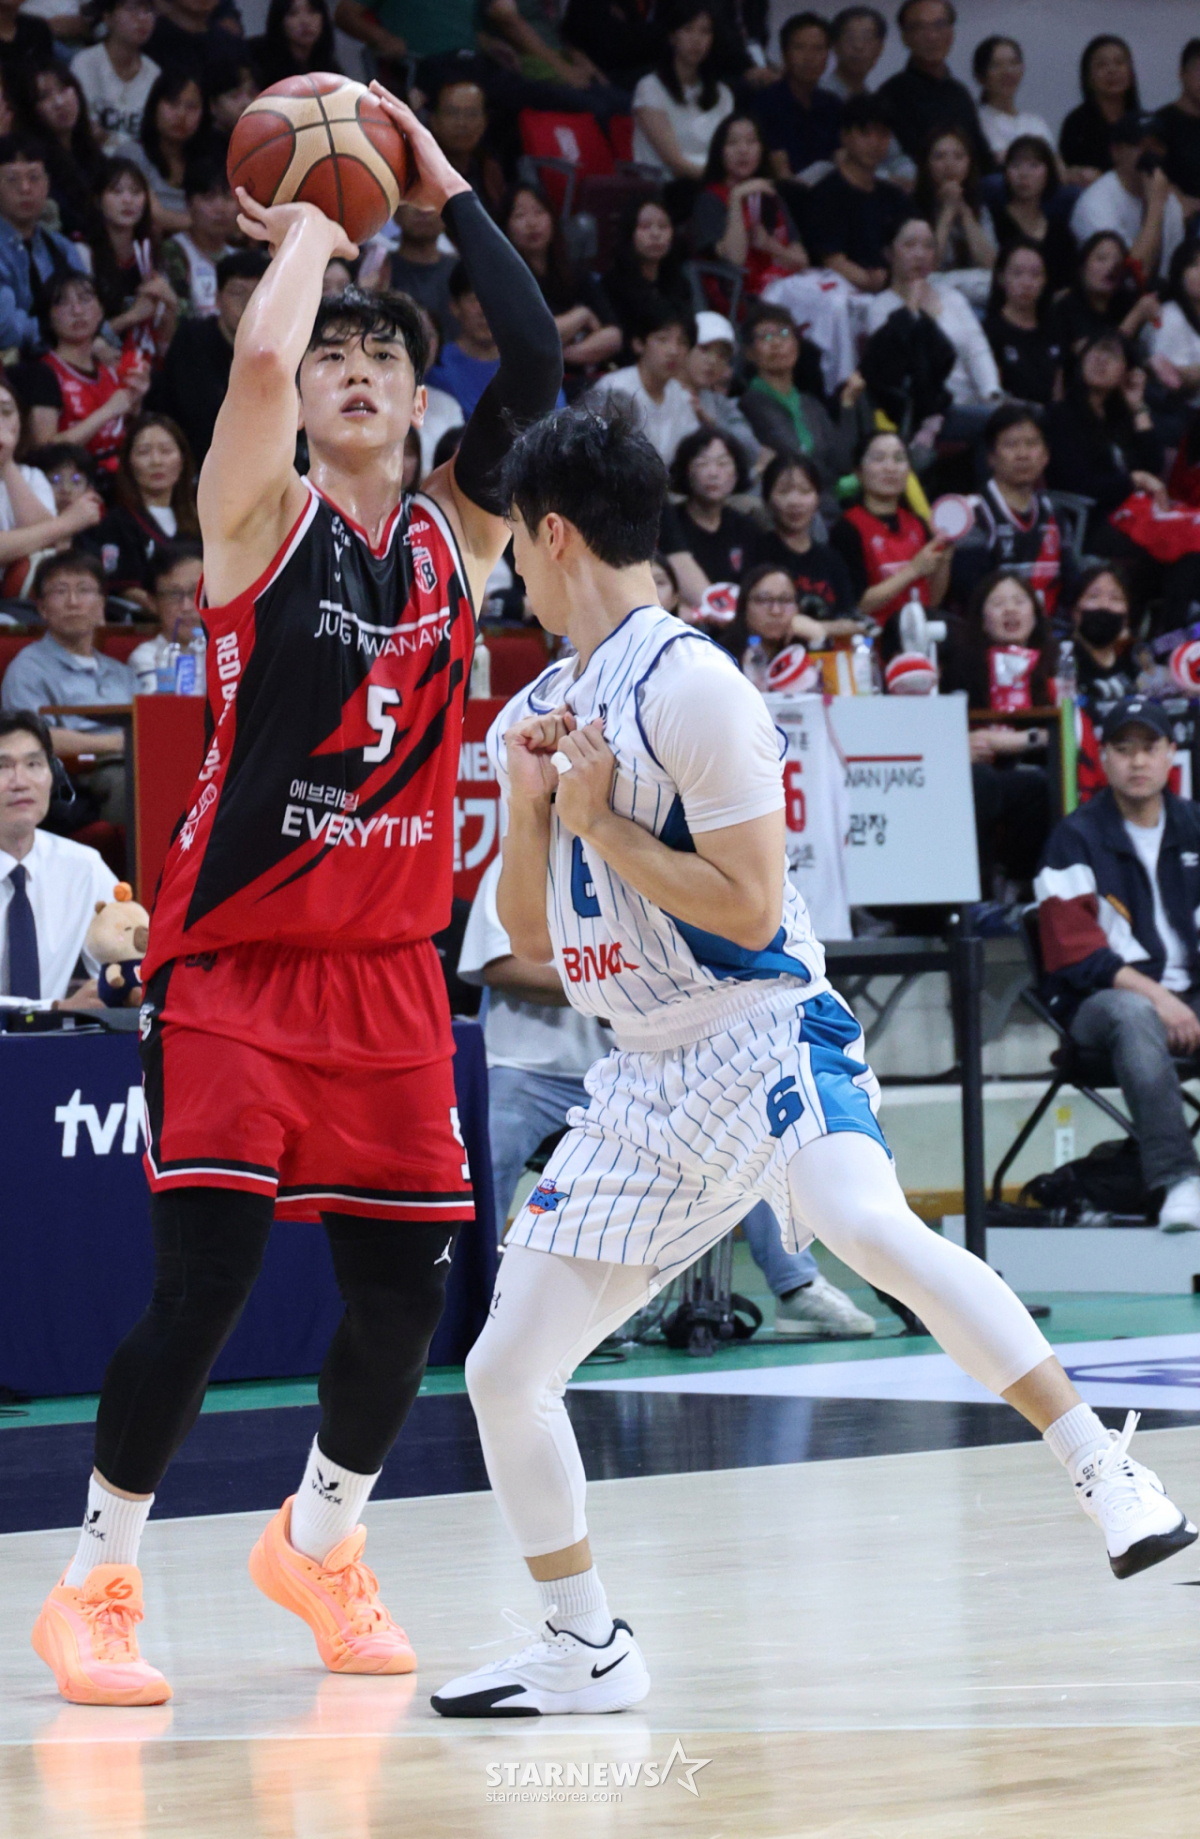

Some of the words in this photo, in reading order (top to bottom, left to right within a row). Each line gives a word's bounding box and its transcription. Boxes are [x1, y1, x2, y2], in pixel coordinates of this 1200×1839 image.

[216, 631, 241, 680] RED
[314, 612, 352, 645] JUG
[363, 684, 400, 763] 5
[766, 1074, 805, 1139] 6
